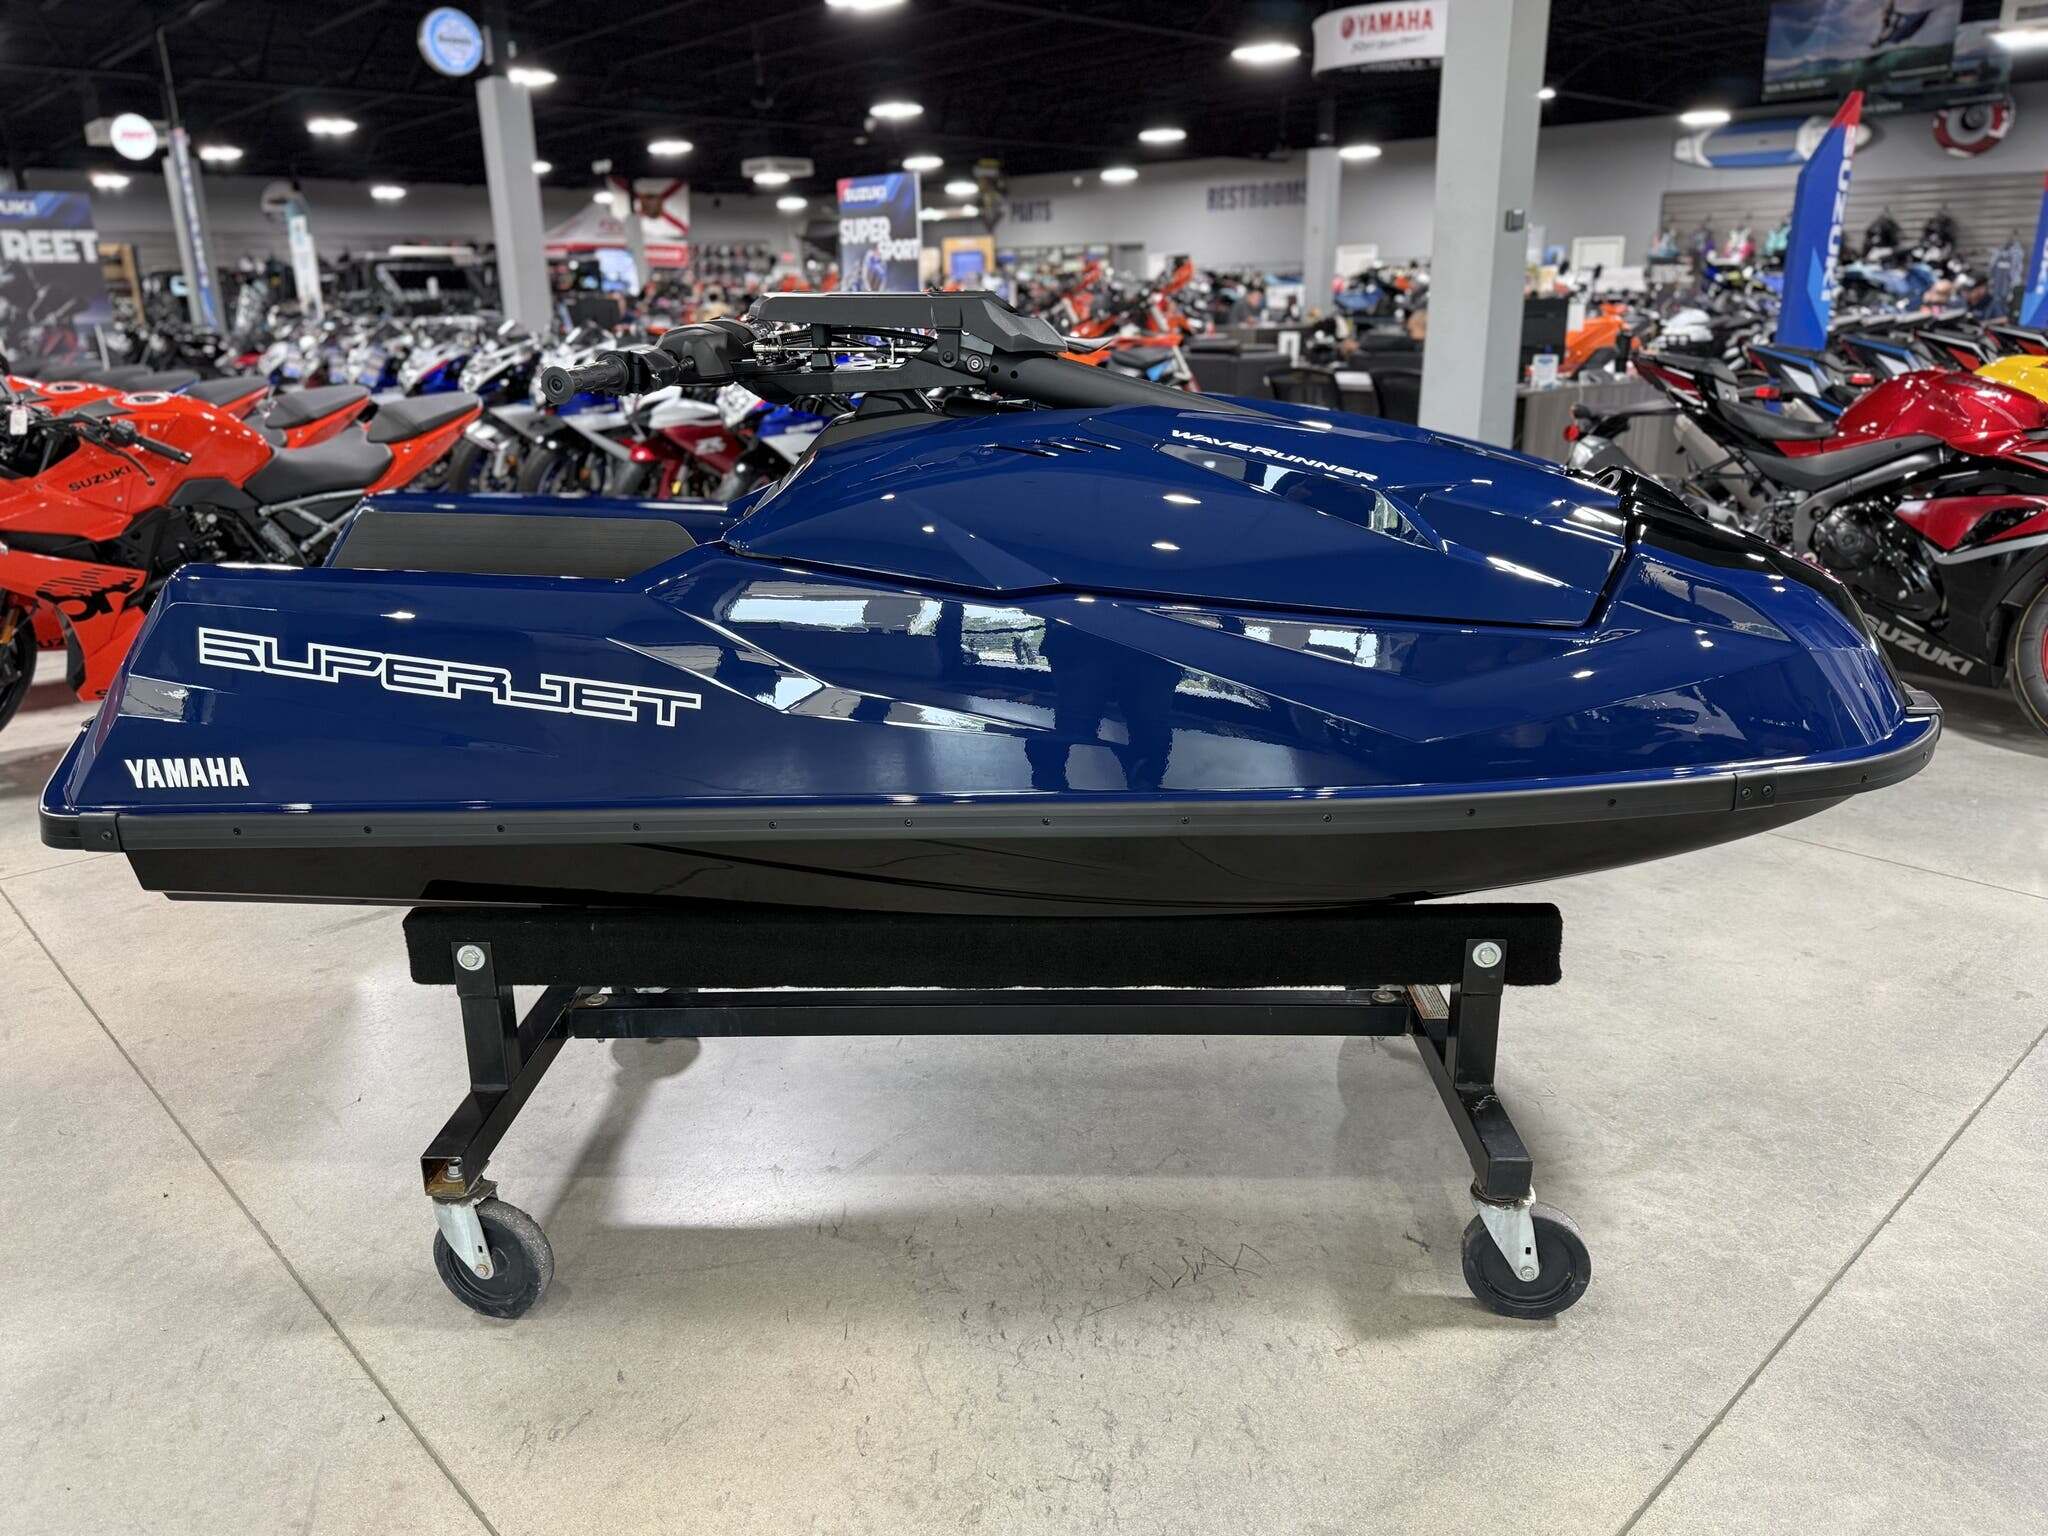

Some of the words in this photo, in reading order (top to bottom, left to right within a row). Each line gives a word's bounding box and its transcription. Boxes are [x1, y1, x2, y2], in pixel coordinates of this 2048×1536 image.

[1358, 8, 1432, 36] YAMAHA
[843, 186, 887, 203] SUZUKI
[839, 216, 890, 245] SUPER
[880, 239, 920, 261] SPORT
[69, 465, 131, 491] SUZUKI
[199, 626, 701, 727] SUPERJET
[124, 757, 250, 788] YAMAHA
